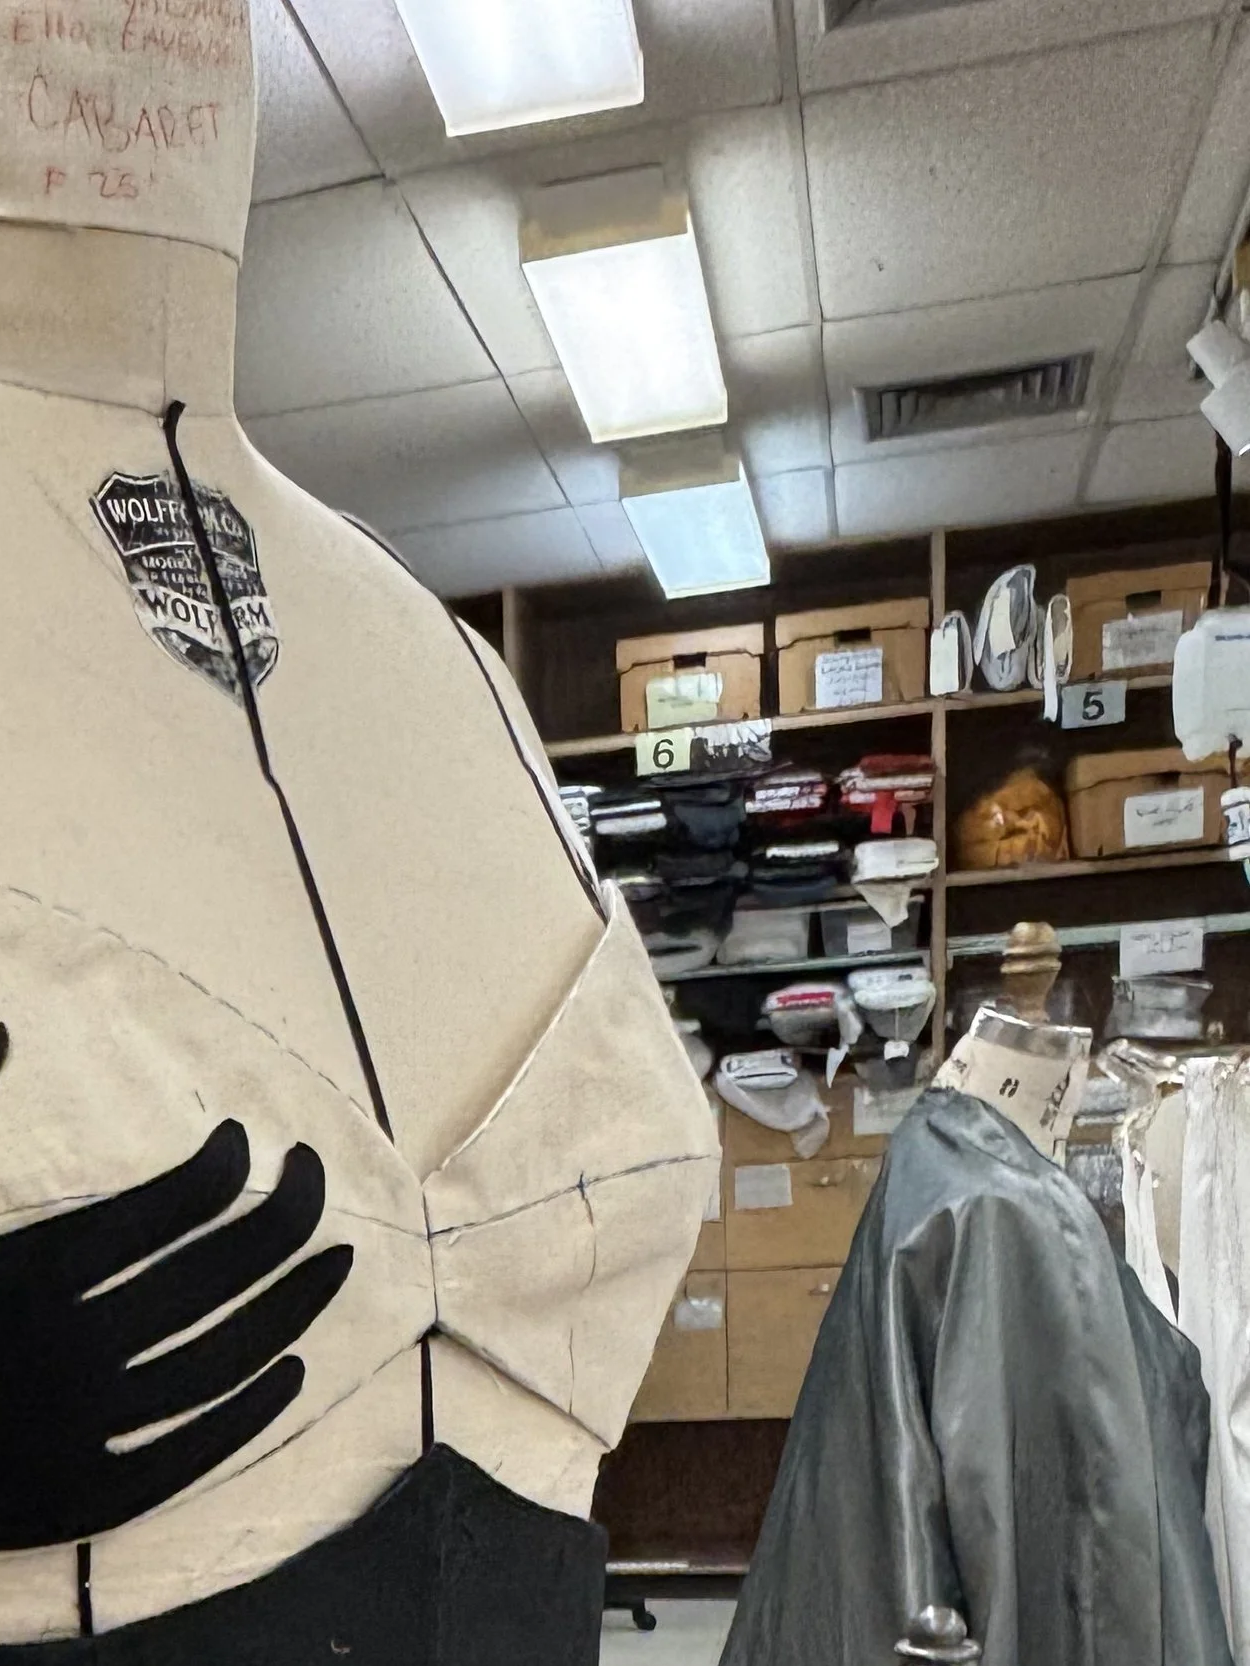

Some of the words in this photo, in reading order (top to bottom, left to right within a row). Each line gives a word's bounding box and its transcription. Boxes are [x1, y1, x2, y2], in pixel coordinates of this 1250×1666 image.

[27, 66, 220, 153] CABARET
[1082, 691, 1105, 721] 5
[652, 738, 675, 769] 6
